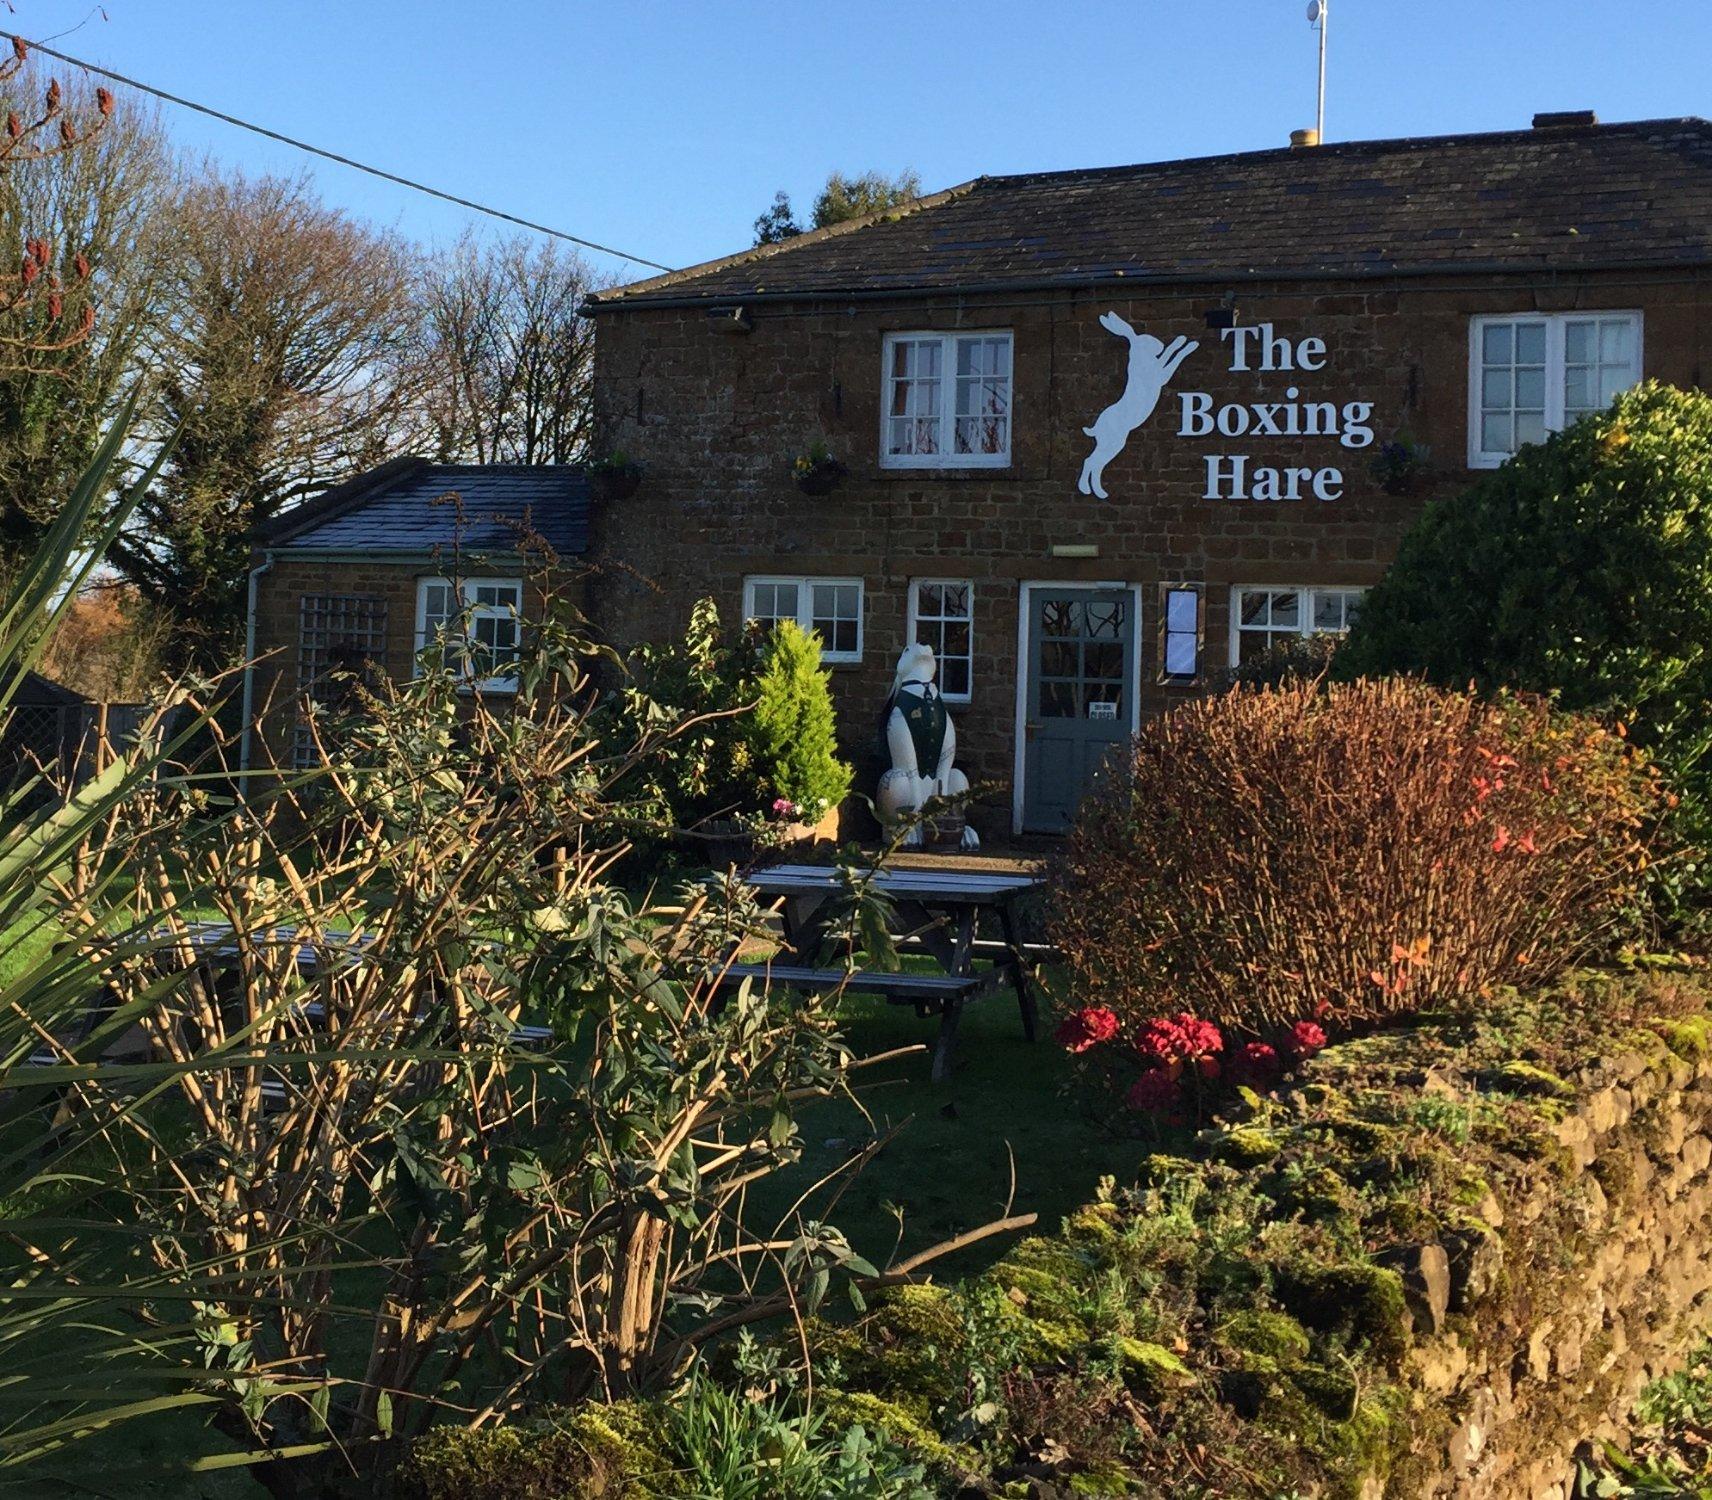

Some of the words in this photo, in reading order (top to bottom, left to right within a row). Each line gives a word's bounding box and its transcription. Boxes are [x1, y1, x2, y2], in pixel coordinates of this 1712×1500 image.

[1220, 322, 1327, 372] The
[1176, 386, 1375, 448] Boxing
[1201, 454, 1344, 501] Hare
